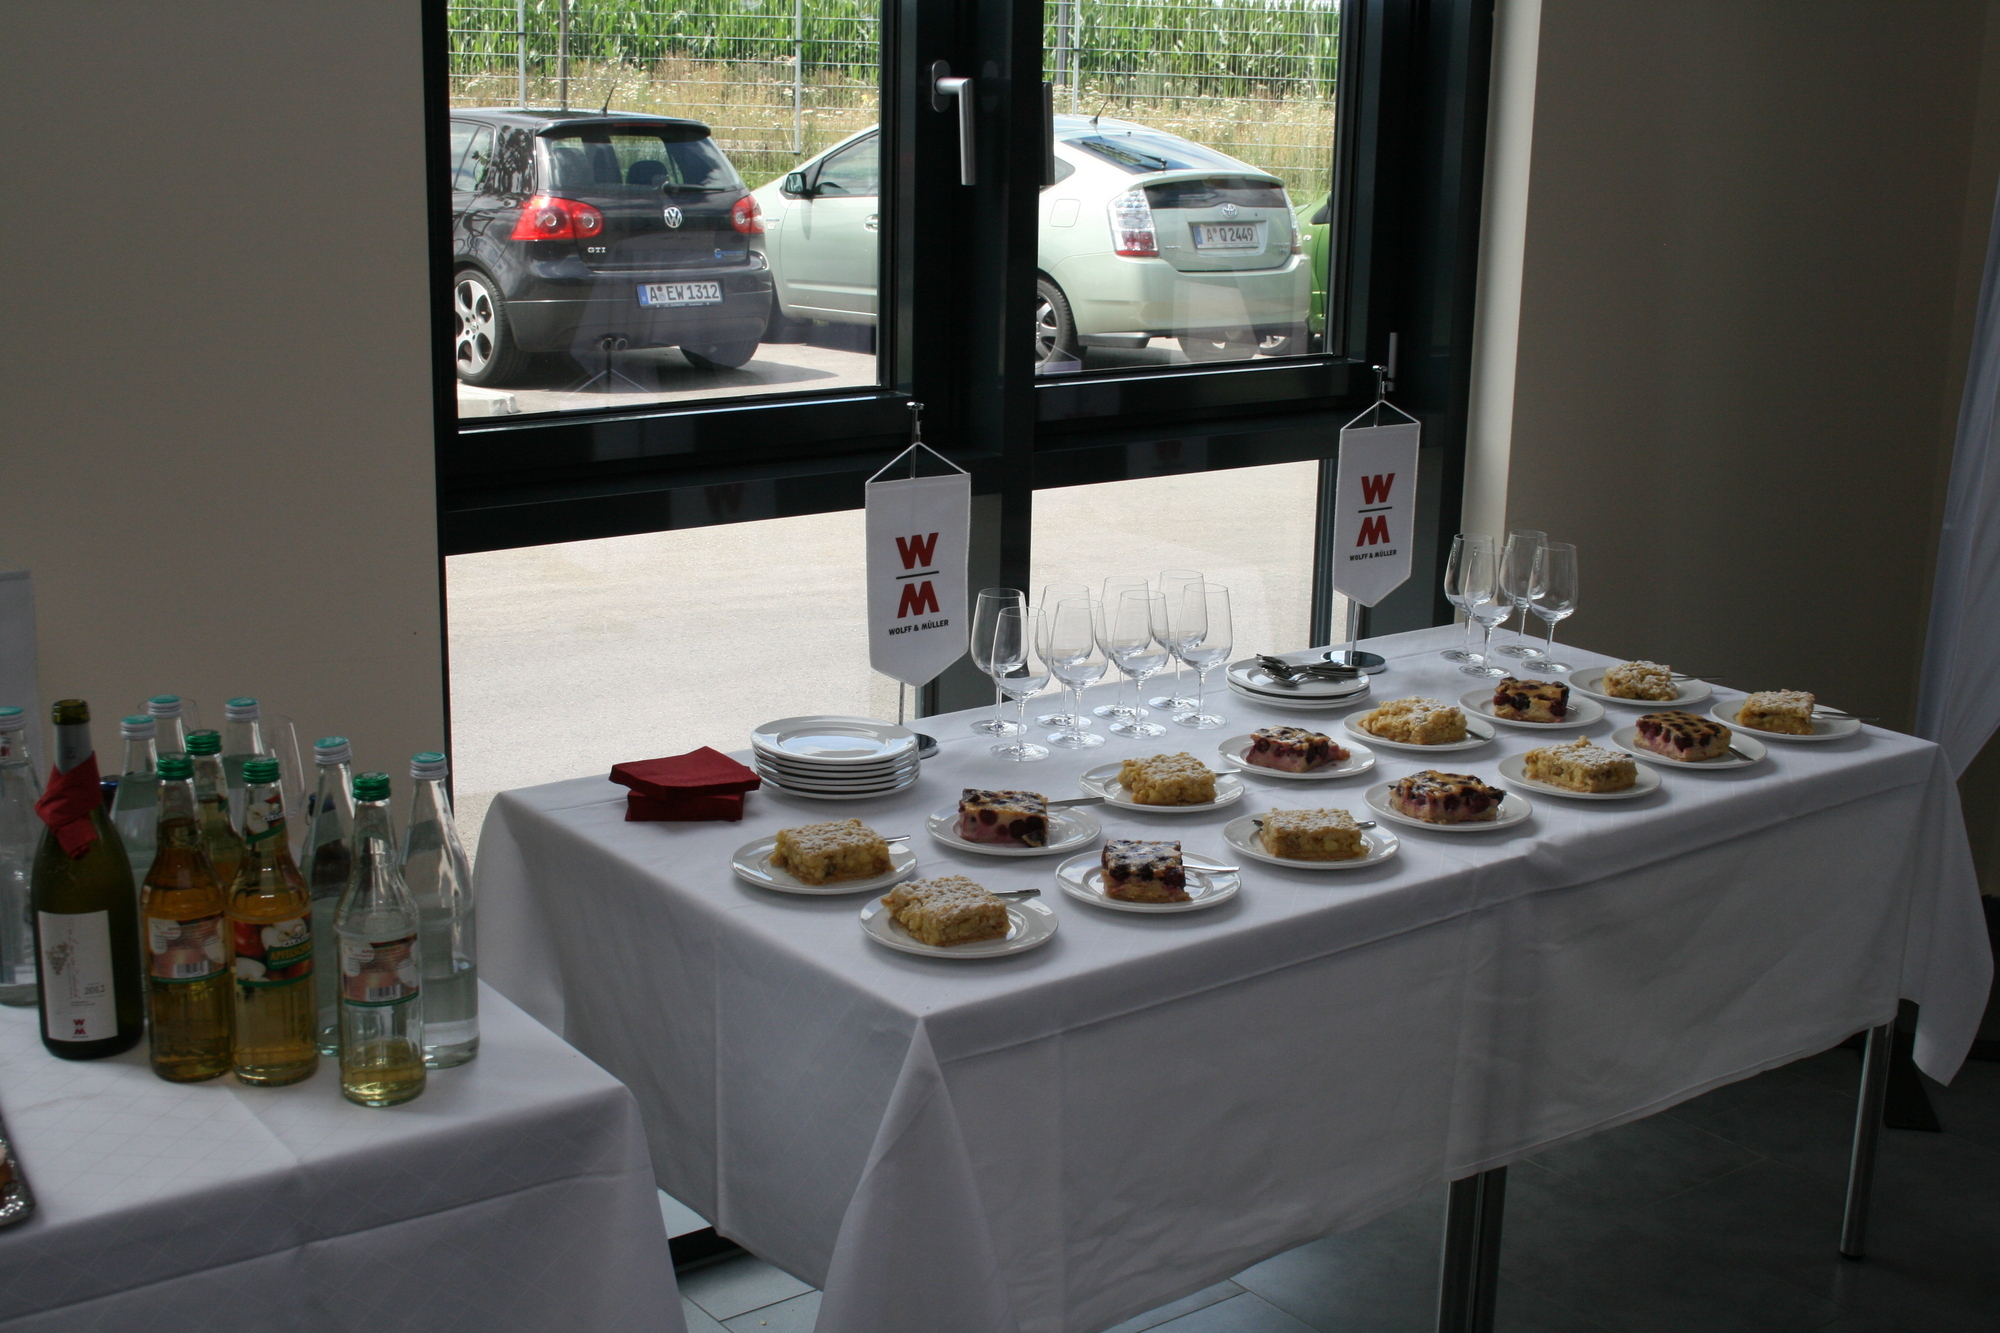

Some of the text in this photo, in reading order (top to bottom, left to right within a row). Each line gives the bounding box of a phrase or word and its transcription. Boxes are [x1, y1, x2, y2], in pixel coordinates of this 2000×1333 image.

[1229, 227, 1254, 242] 2449
[650, 287, 659, 303] A
[666, 285, 685, 301] EW
[687, 284, 719, 300] 1312
[1361, 473, 1396, 505] W
[1356, 515, 1390, 547] M
[895, 532, 939, 570] W
[1350, 553, 1368, 561] WOLFF
[1374, 549, 1397, 558] MÜLLER
[897, 580, 940, 619] M
[888, 619, 949, 636] WOLFF & MÜLLER
[84, 985, 106, 995] 2012
